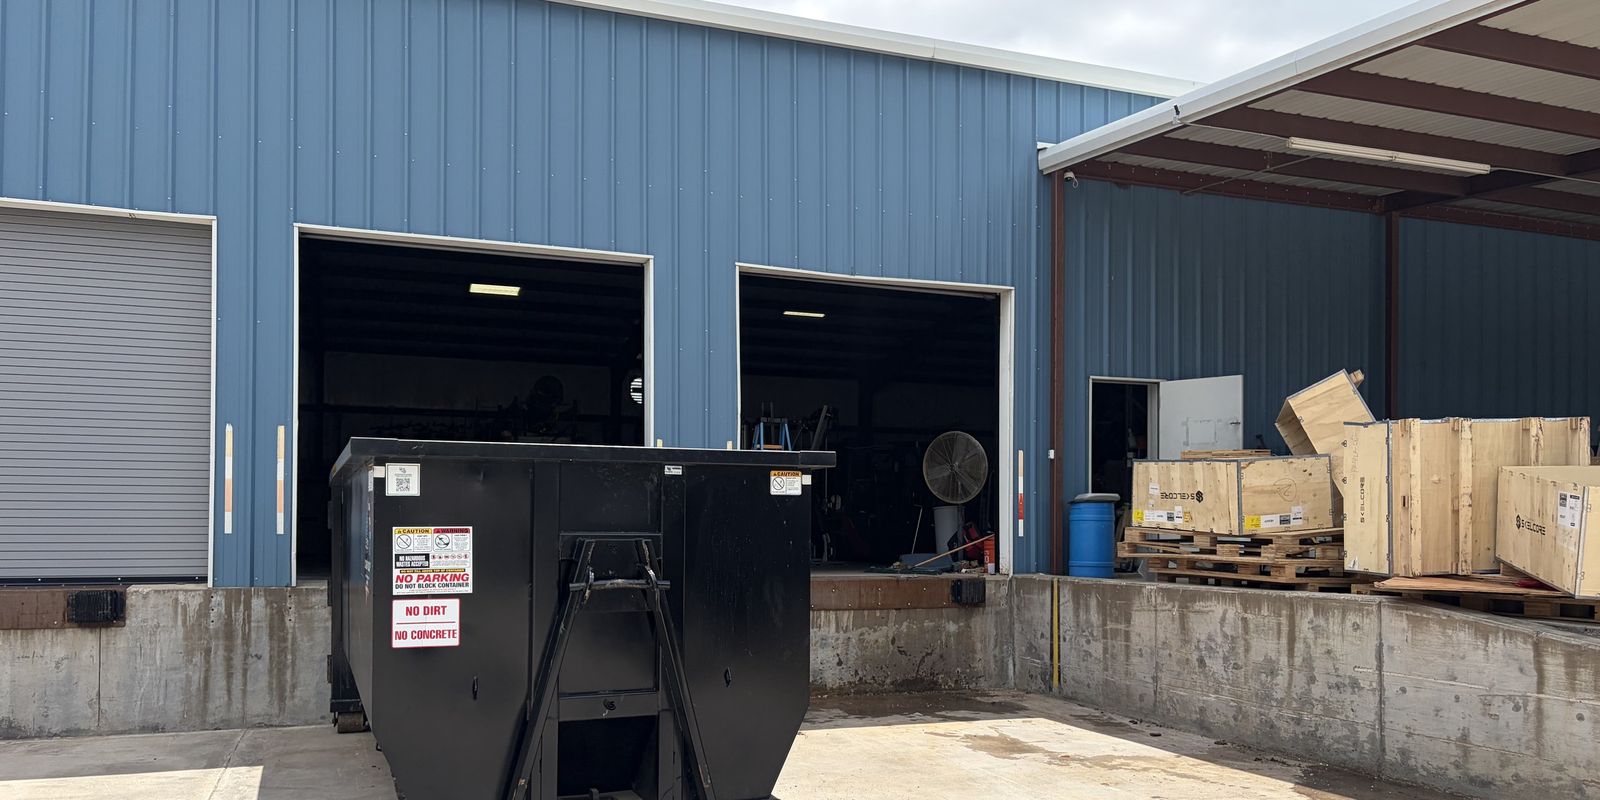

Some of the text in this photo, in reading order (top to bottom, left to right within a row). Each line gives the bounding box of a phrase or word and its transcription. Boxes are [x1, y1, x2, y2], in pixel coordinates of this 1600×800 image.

[1160, 492, 1195, 500] SKELCORE
[1521, 519, 1546, 536] SKELCORE
[395, 573, 470, 583] NO PARKING
[405, 605, 447, 616] NO DIRT
[394, 629, 457, 640] NO CONCRETE
